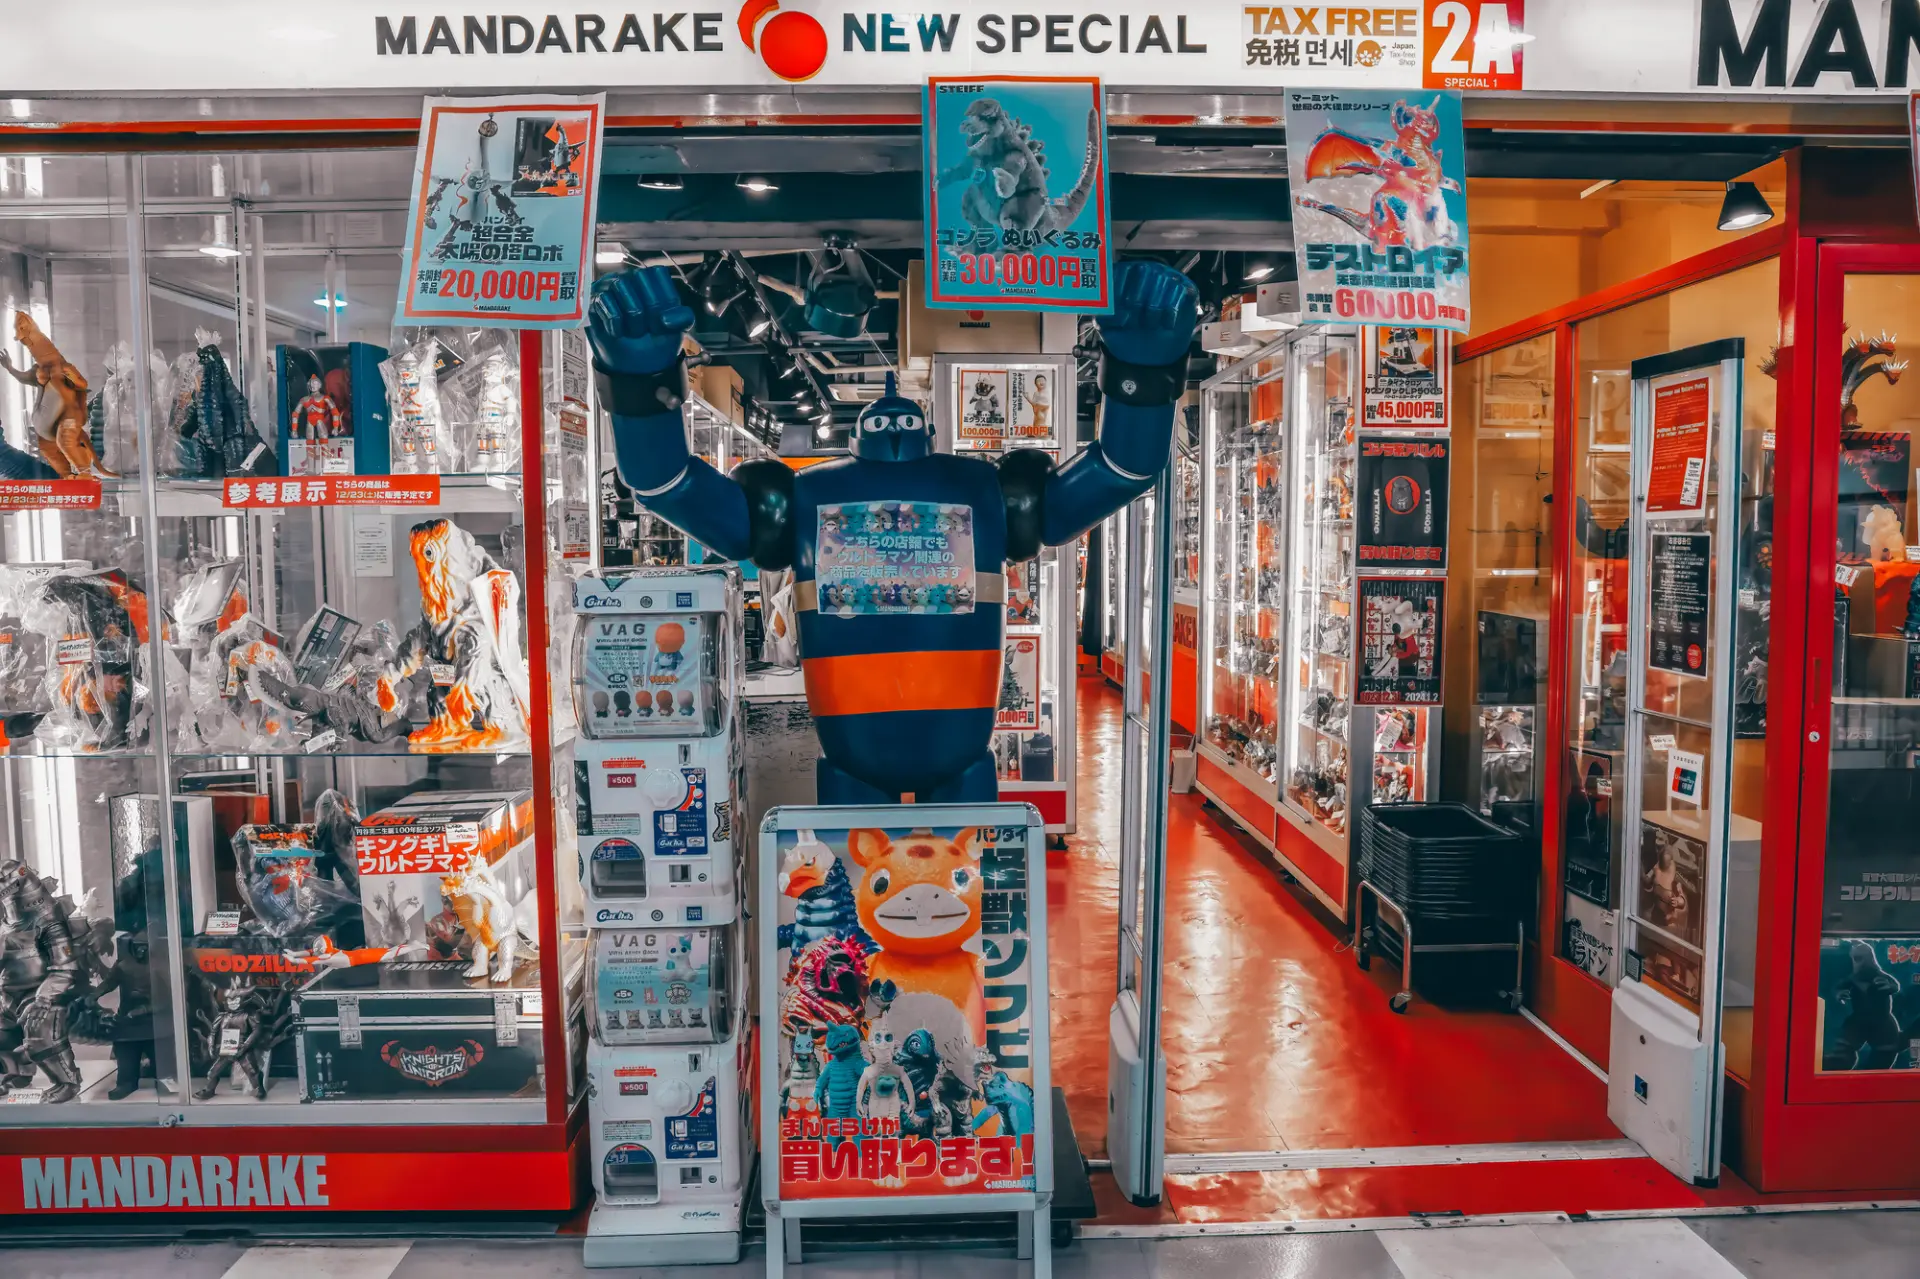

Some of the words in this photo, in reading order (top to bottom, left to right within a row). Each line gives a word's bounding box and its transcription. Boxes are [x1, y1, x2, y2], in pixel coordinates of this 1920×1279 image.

[1244, 7, 1320, 36] TAX
[1326, 8, 1417, 37] FREE
[376, 13, 723, 55] MANDARAKE
[843, 13, 961, 52] NEW
[976, 13, 1208, 54] SPECIAL
[1431, 1, 1515, 74] 2A
[1246, 38, 1300, 67] 免税
[1305, 38, 1353, 67] 면세
[1389, 51, 1416, 60] Tax-free
[1391, 42, 1416, 51] Japan.
[1398, 59, 1416, 67] Shop
[939, 85, 985, 94] STEIFF
[1444, 78, 1490, 88] SPECIAL
[1492, 78, 1498, 88] 1
[471, 225, 535, 243] 超合金
[1001, 228, 1102, 251] ぬいぐるみ
[438, 242, 565, 262] 太陽の塔ロボ
[1306, 243, 1465, 275] デストロイア
[417, 269, 442, 282] 未開封
[959, 253, 1081, 289] 30,000円
[1081, 258, 1097, 289] 買取
[438, 268, 561, 302] 20,000円
[559, 271, 577, 300] 買取
[1376, 401, 1435, 421] 45,000円
[228, 480, 328, 504] 参考展示
[335, 480, 390, 489] こちらの商品は
[843, 536, 949, 550] こちらの店舗でも
[829, 565, 962, 579] 商品を販売しています
[601, 623, 646, 636] VAG
[612, 776, 632, 784] ¥500
[976, 827, 1027, 843] バンダイ
[358, 852, 471, 875] ウルトラマン
[612, 934, 657, 948] VAG
[401, 1060, 467, 1081] UNICRON
[402, 1052, 465, 1070] KNIGHTS
[624, 1083, 645, 1091] ¥500
[782, 1117, 900, 1138] まんだらけが
[781, 1133, 1035, 1183] 買い取ります!
[21, 1154, 330, 1209] MANDARAKE
